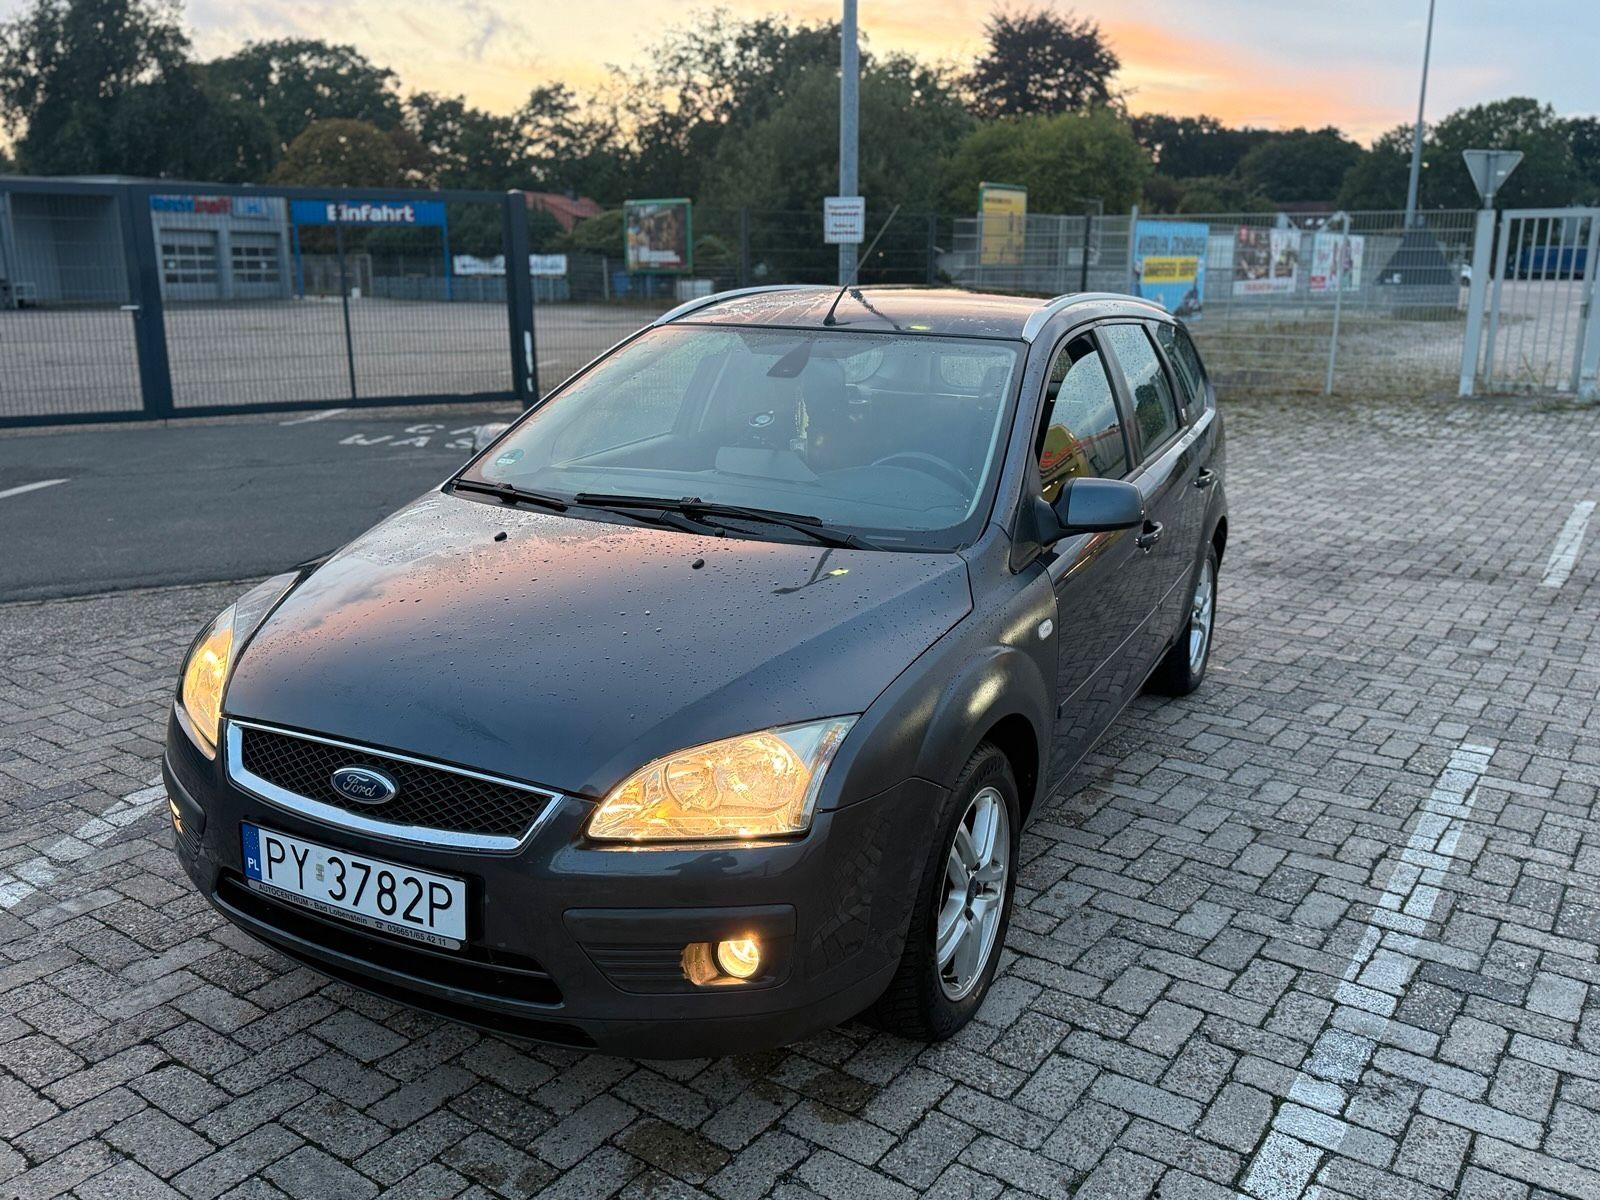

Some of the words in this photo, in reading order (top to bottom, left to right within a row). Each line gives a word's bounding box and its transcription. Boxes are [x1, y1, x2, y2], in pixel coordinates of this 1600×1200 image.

[326, 203, 415, 222] Einfahrt
[342, 774, 377, 797] Ford
[247, 857, 260, 872] PL
[266, 837, 310, 890] PY
[328, 857, 453, 927] 3782P
[258, 883, 309, 906] AUTOCENTRUM
[314, 902, 328, 912] Bad
[329, 906, 368, 924] Lobenstein
[426, 935, 436, 944] 42
[438, 938, 446, 946] 11
